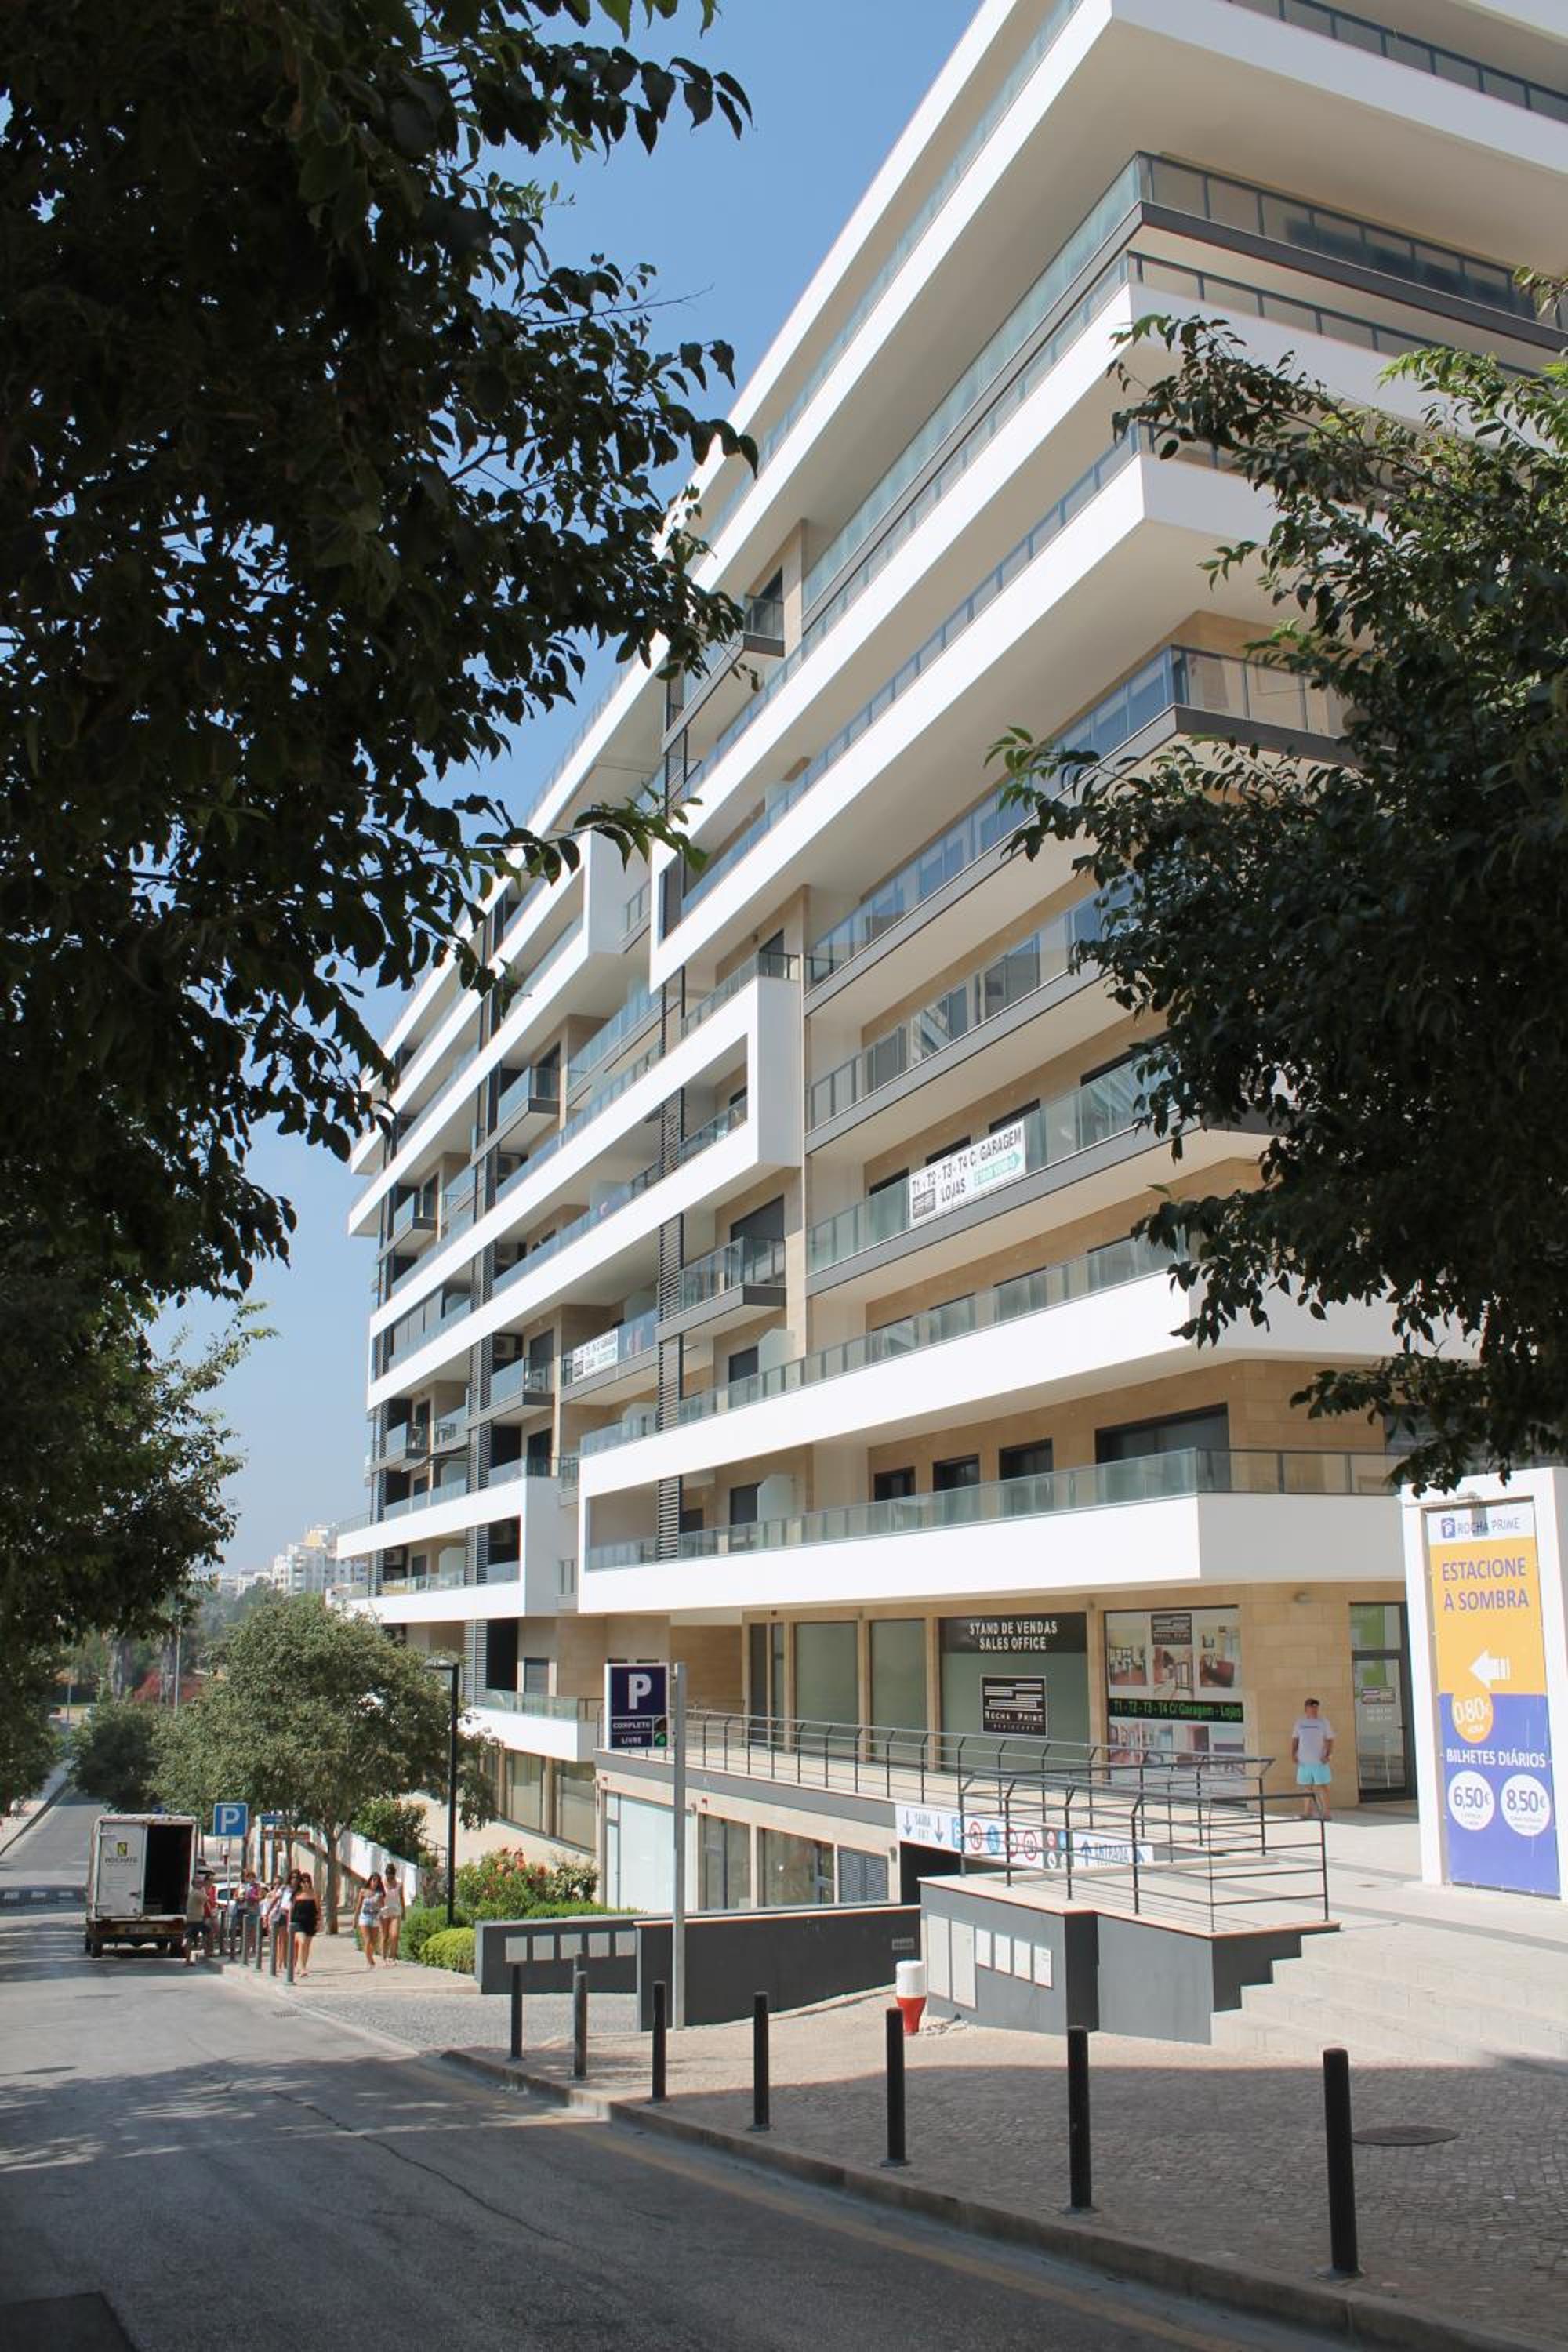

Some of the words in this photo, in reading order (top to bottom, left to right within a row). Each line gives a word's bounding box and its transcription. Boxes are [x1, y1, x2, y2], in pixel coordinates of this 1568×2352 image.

[942, 1162, 953, 1181] T3
[981, 1126, 1022, 1162] GARAGEM
[941, 1178, 966, 1203] LOJAS
[1457, 1519, 1489, 1535] ROCHA
[1491, 1517, 1522, 1531] PRIME
[1442, 1556, 1527, 1581] ESTACIONE
[1444, 1588, 1454, 1612] À
[1457, 1588, 1530, 1611] SOMBRA
[969, 1622, 999, 1635] STAND
[1001, 1621, 1014, 1635] DE
[1016, 1620, 1058, 1634] VENDAS
[979, 1636, 1009, 1650] SALES
[1011, 1636, 1047, 1650] OFFICE
[628, 1674, 652, 1710] P
[1446, 1748, 1496, 1766] BILHETES
[1498, 1748, 1547, 1769] DIÁRIOS
[220, 1806, 241, 1834] P
